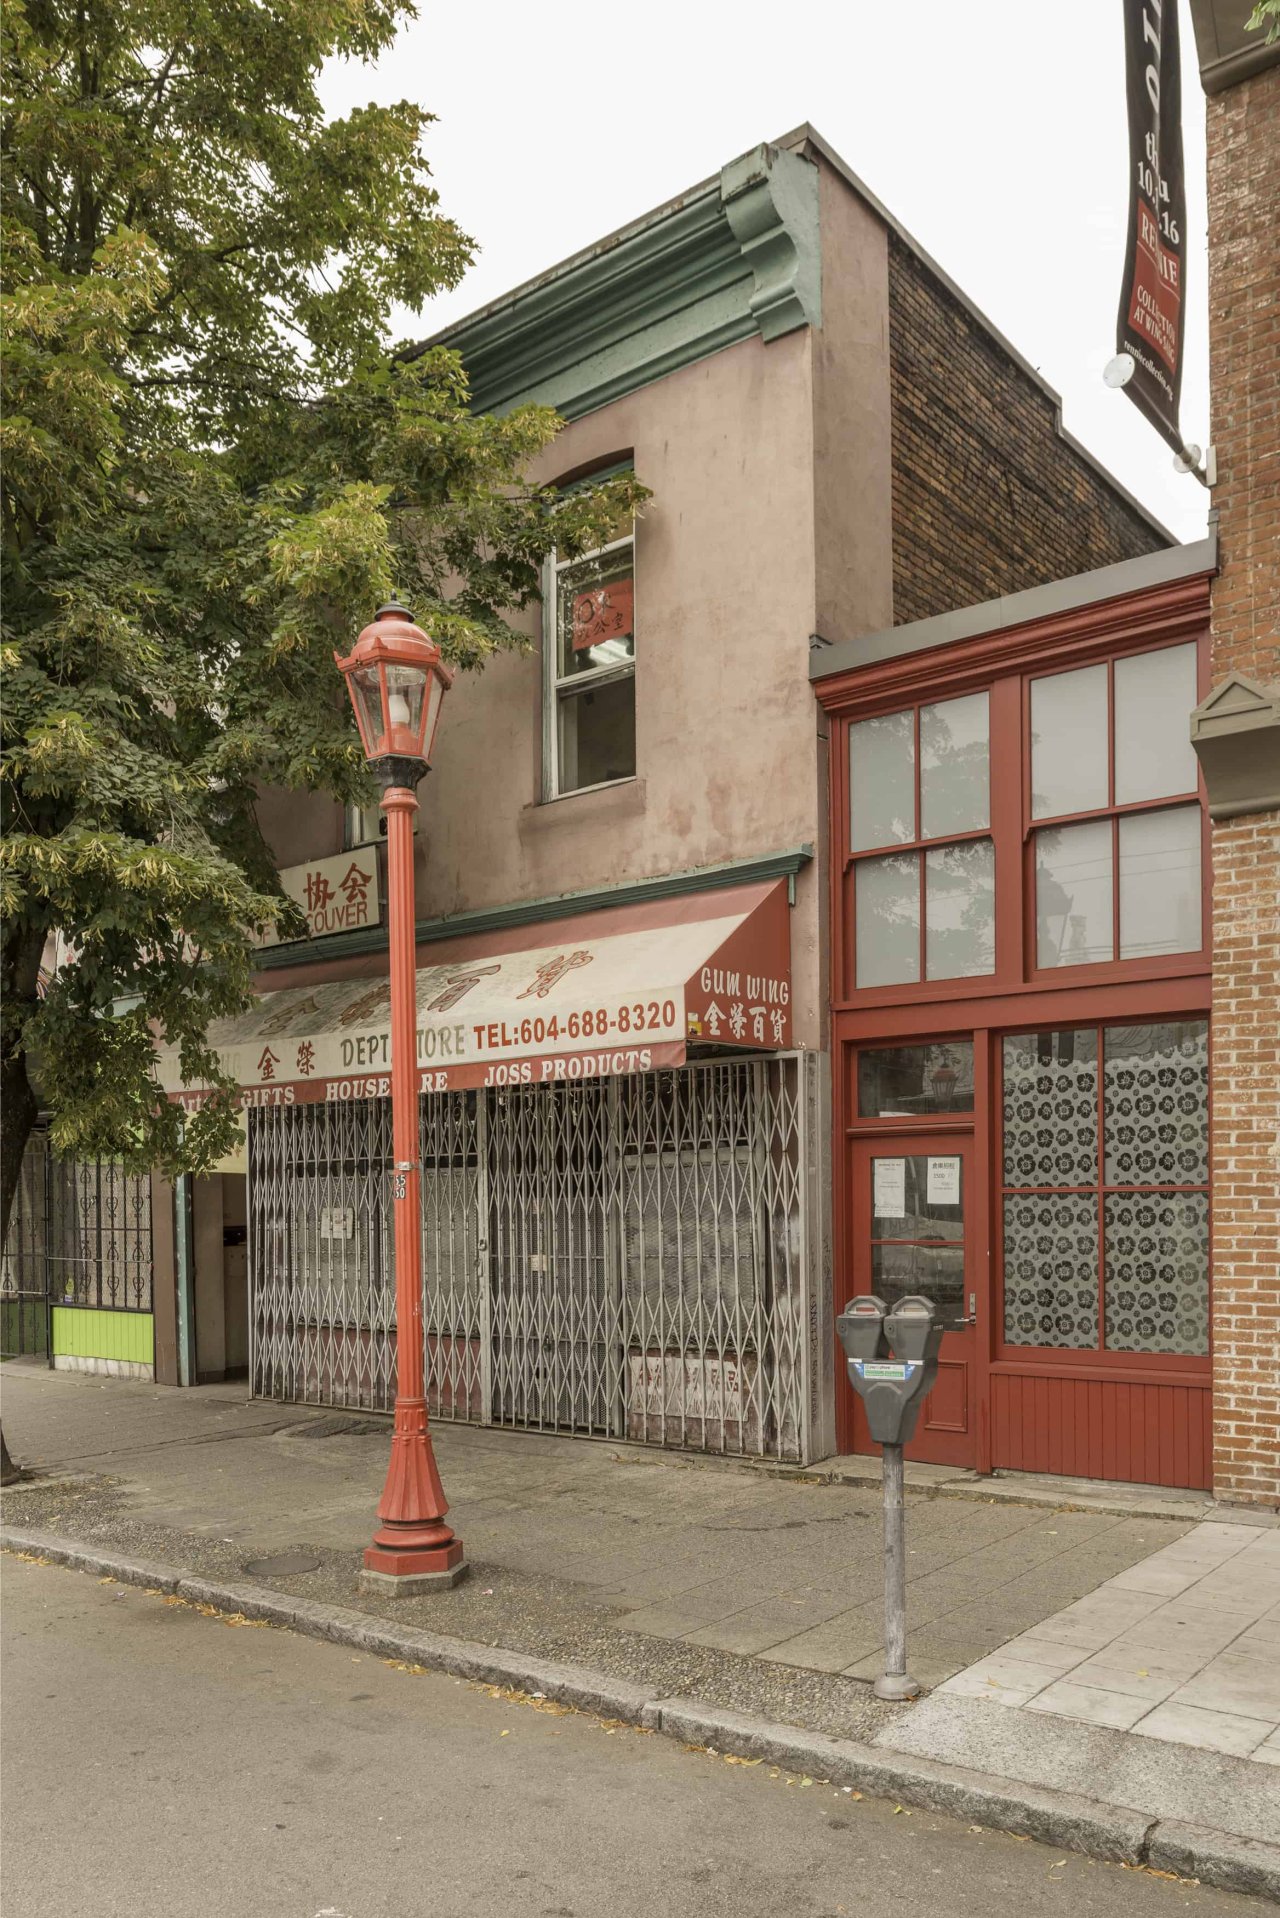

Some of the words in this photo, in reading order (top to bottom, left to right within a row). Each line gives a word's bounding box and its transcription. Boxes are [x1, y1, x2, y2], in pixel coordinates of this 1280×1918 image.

[1145, 132, 1170, 203] thu
[1134, 305, 1144, 325] AT
[1145, 313, 1163, 345] WING
[1137, 284, 1176, 346] COLLECTION
[305, 901, 368, 934] COUVER
[701, 967, 741, 997] GUM
[747, 974, 789, 1005] WING
[416, 1024, 465, 1059] TORE
[241, 1085, 296, 1109] GIFTS
[325, 1071, 448, 1102] HOUSERE
[484, 1061, 532, 1087] JOSS
[541, 1049, 652, 1081] PRODUCTS
